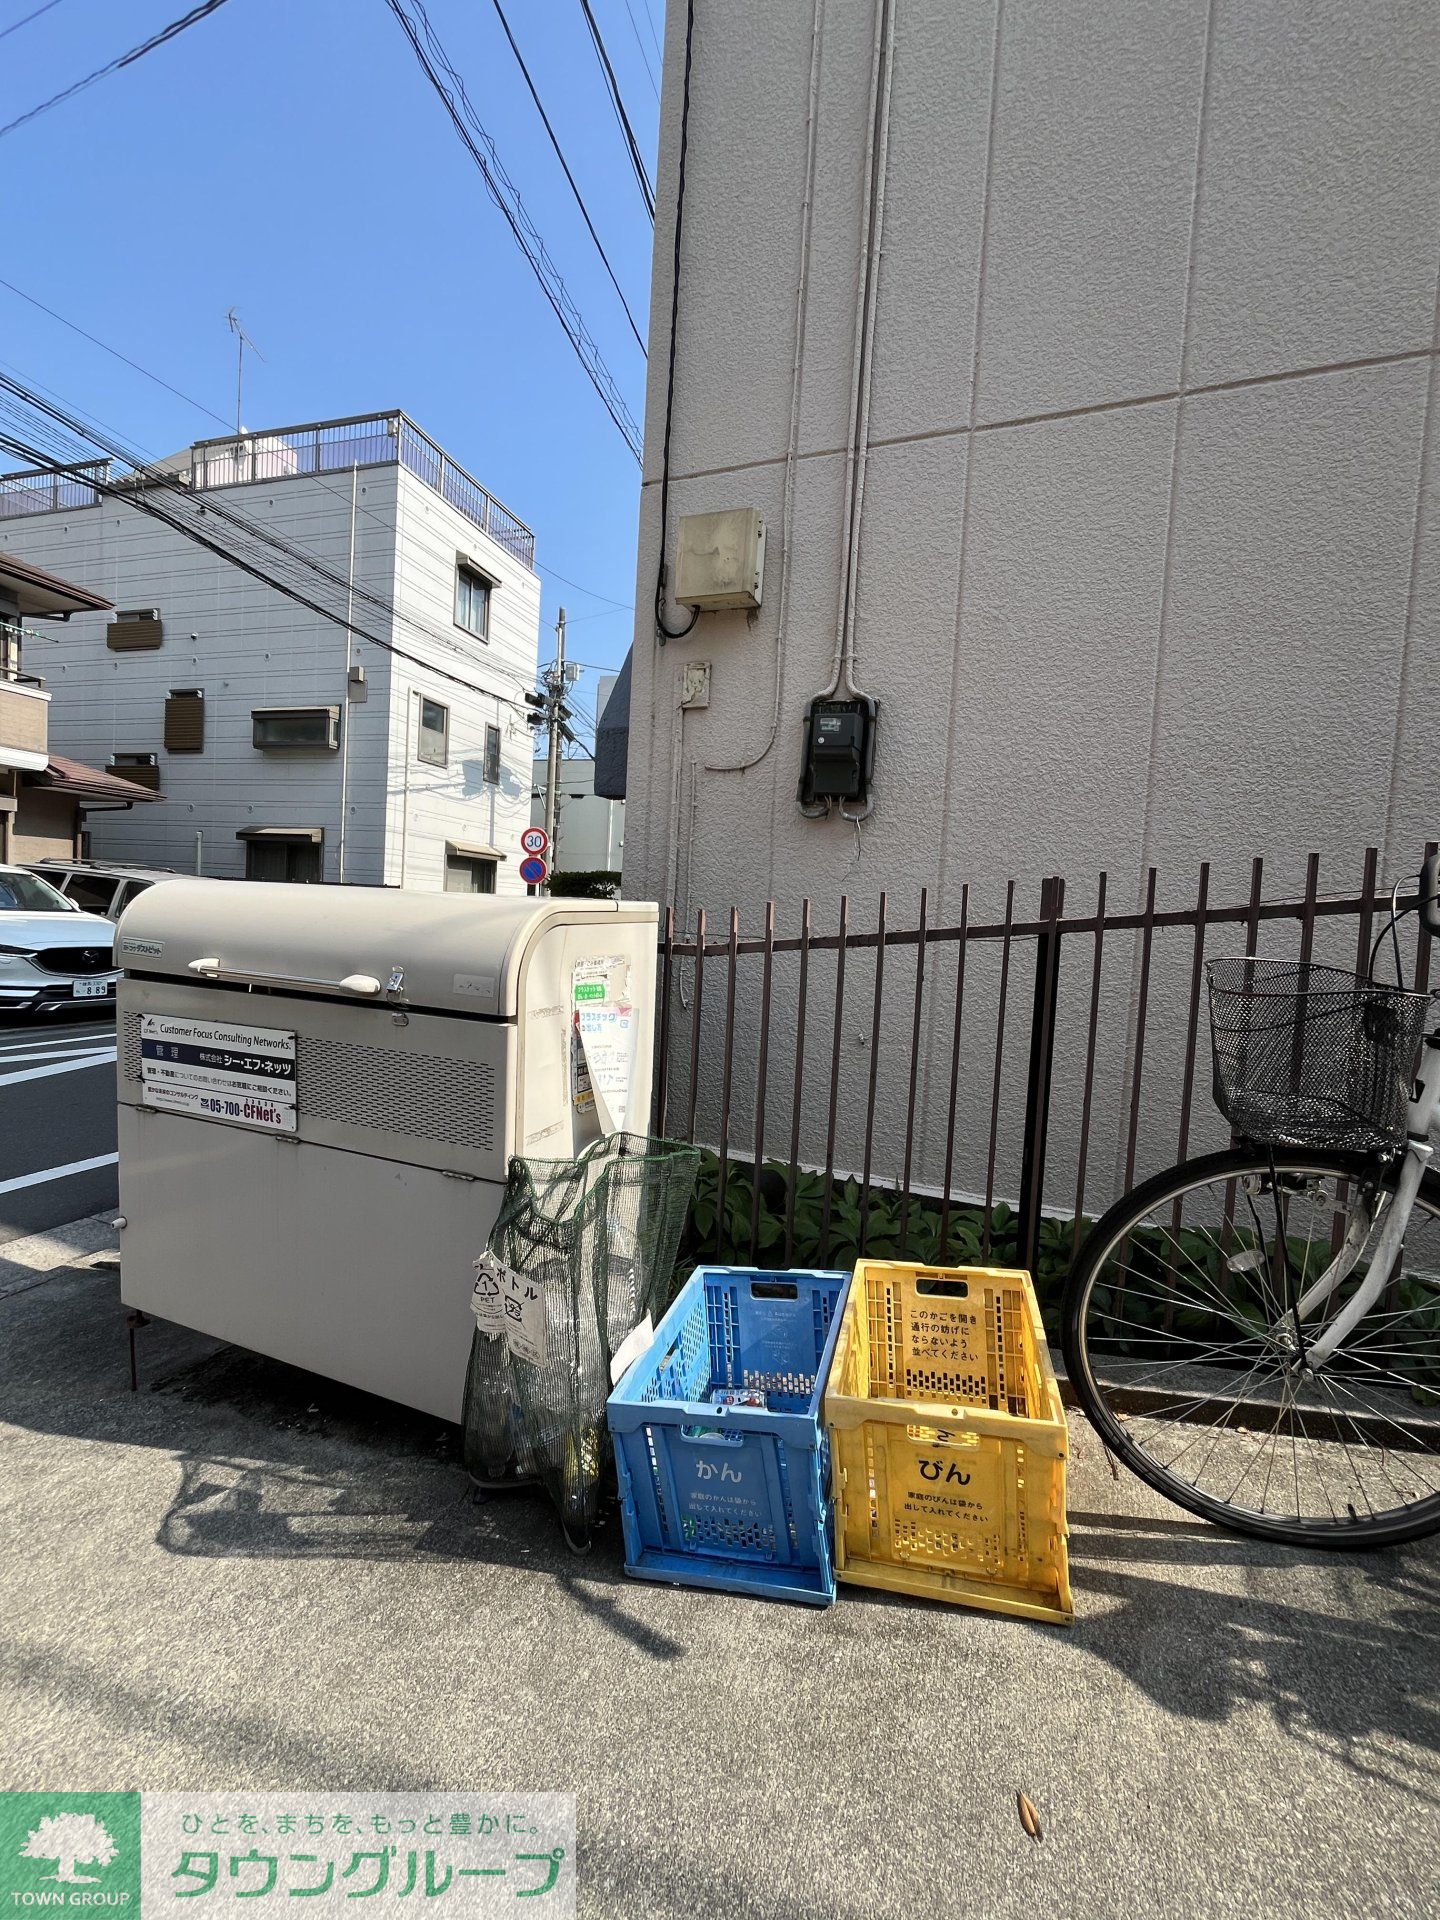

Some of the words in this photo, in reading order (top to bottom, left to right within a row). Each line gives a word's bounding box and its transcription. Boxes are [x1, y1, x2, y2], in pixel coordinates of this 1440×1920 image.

[526, 835, 542, 848] 30
[160, 1023, 192, 1037] Customer
[193, 1027, 213, 1040] Focus
[214, 1030, 252, 1047] Consulting
[253, 1036, 292, 1050] Networks.
[223, 1054, 292, 1075] シー・エフ・ネッツ
[480, 1296, 495, 1304] PET
[910, 1309, 977, 1325] このかごを開き
[911, 1321, 970, 1336] 通行の妨げに
[912, 1334, 967, 1349] ならないよう
[912, 1346, 979, 1361] 並べてください
[695, 1459, 742, 1483] かん
[918, 1459, 971, 1487] びん
[907, 1491, 983, 1510] 家庭のびんは袋から
[904, 1503, 988, 1522] 出して入れてください
